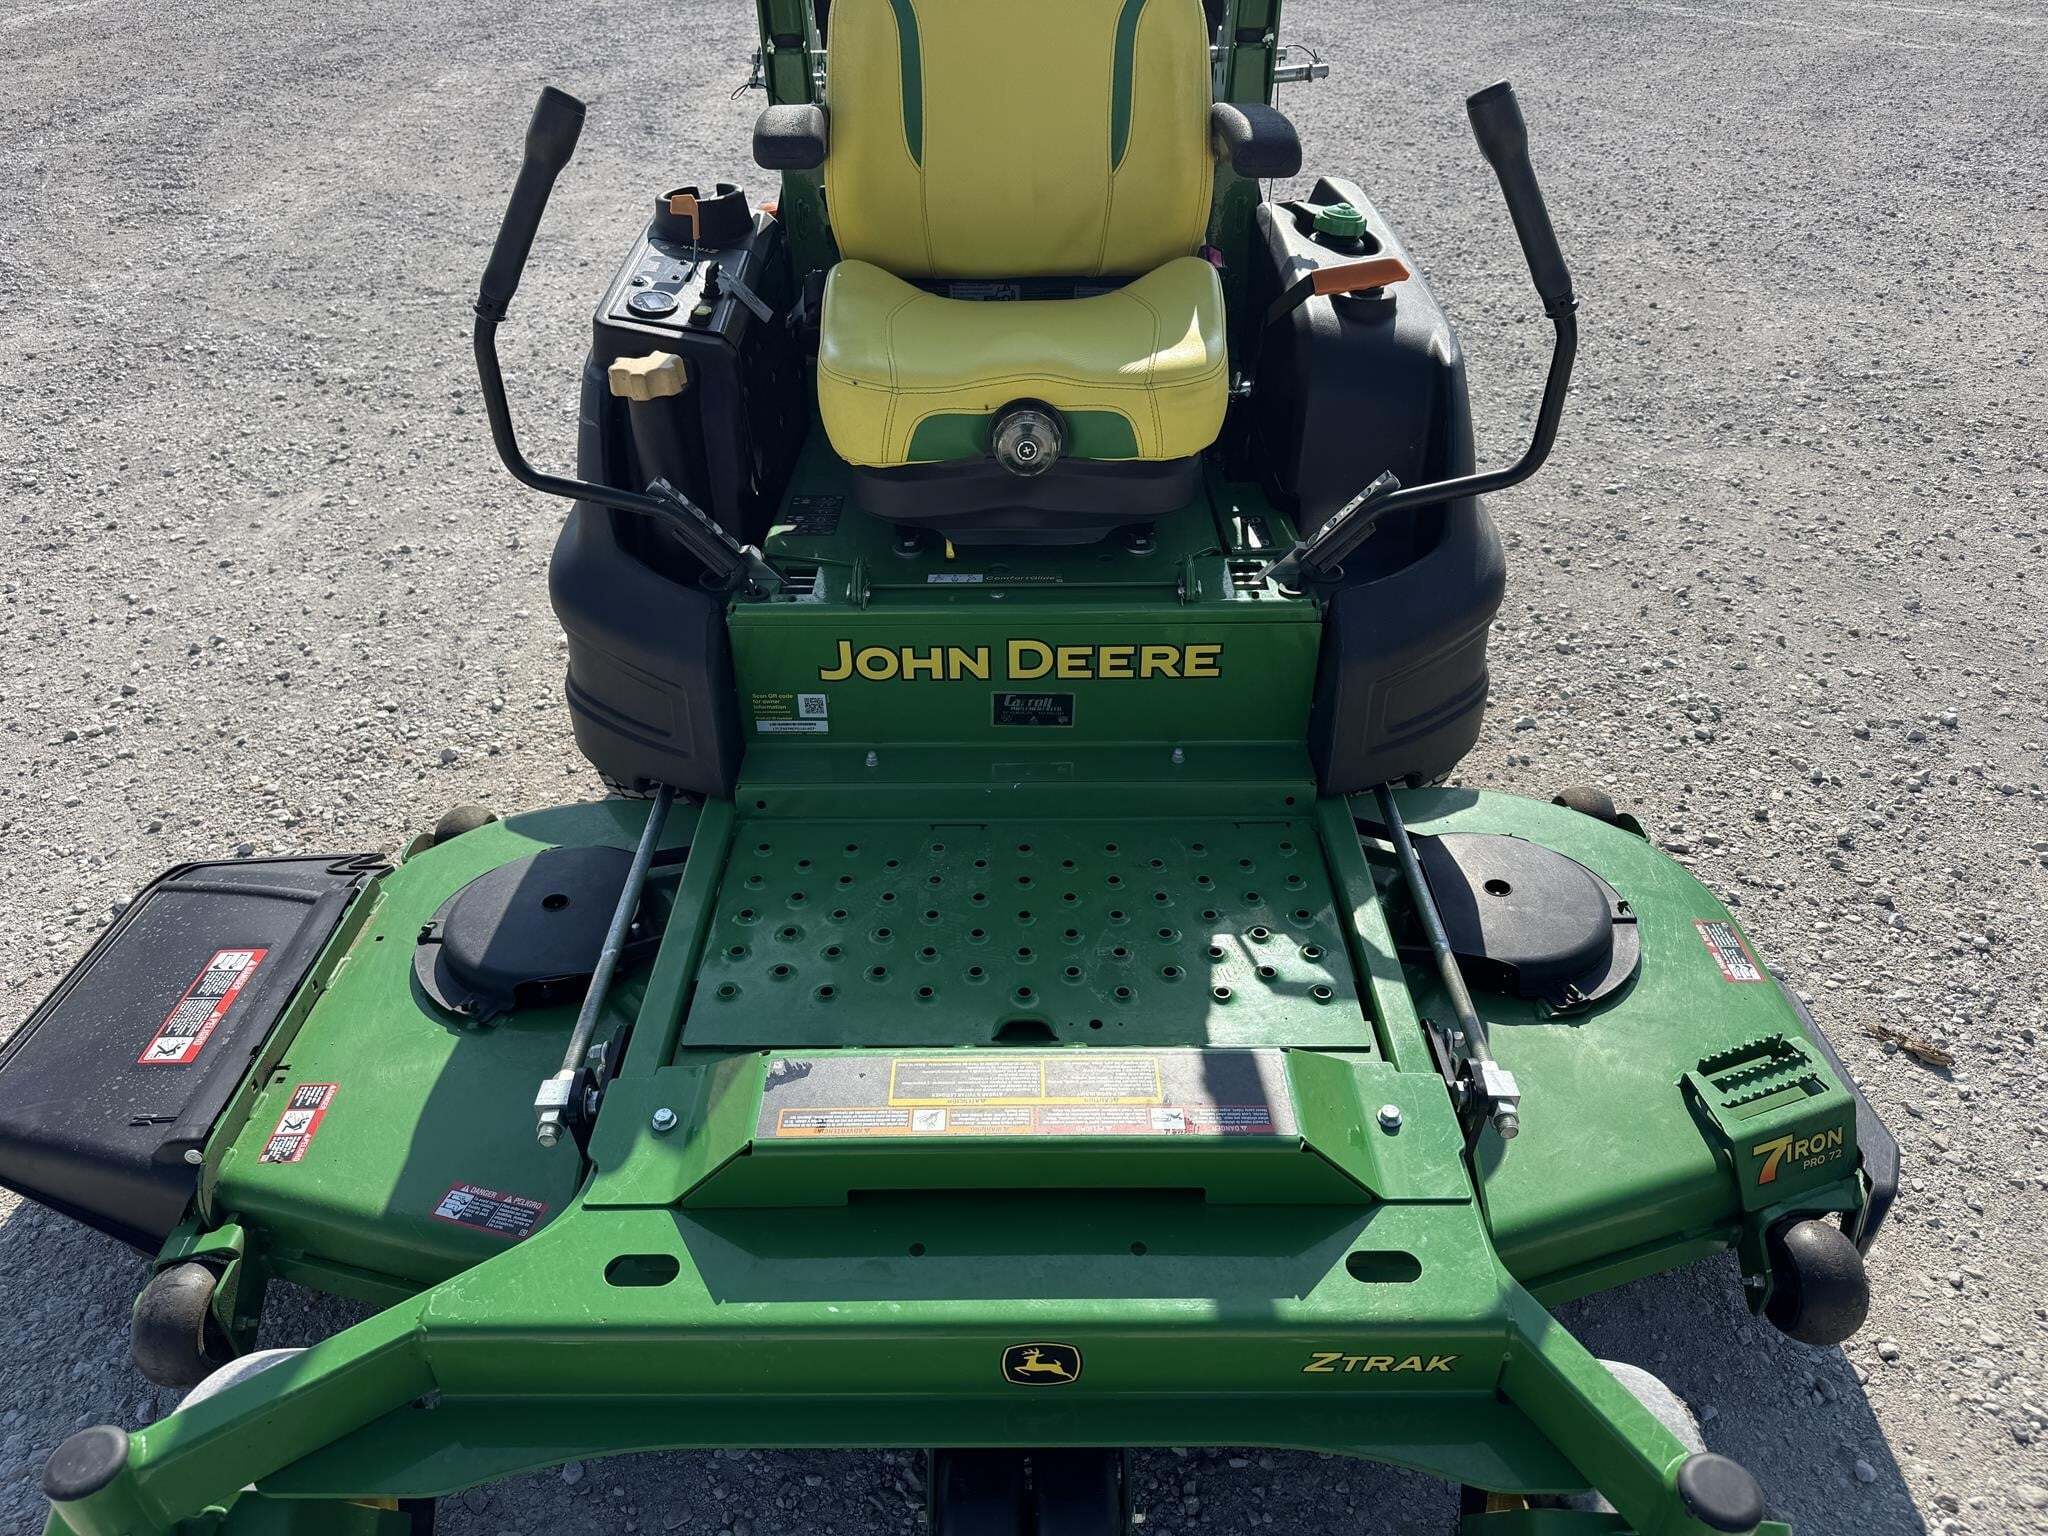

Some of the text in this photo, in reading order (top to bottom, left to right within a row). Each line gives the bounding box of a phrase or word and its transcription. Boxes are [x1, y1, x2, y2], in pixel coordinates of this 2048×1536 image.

[820, 638, 1224, 682] JOHN DEERE
[1803, 1149, 1842, 1170] PRO 72
[471, 1186, 498, 1199] DANGER
[513, 1196, 543, 1210] PELIGRO
[1302, 1351, 1461, 1373] ZTRAK
